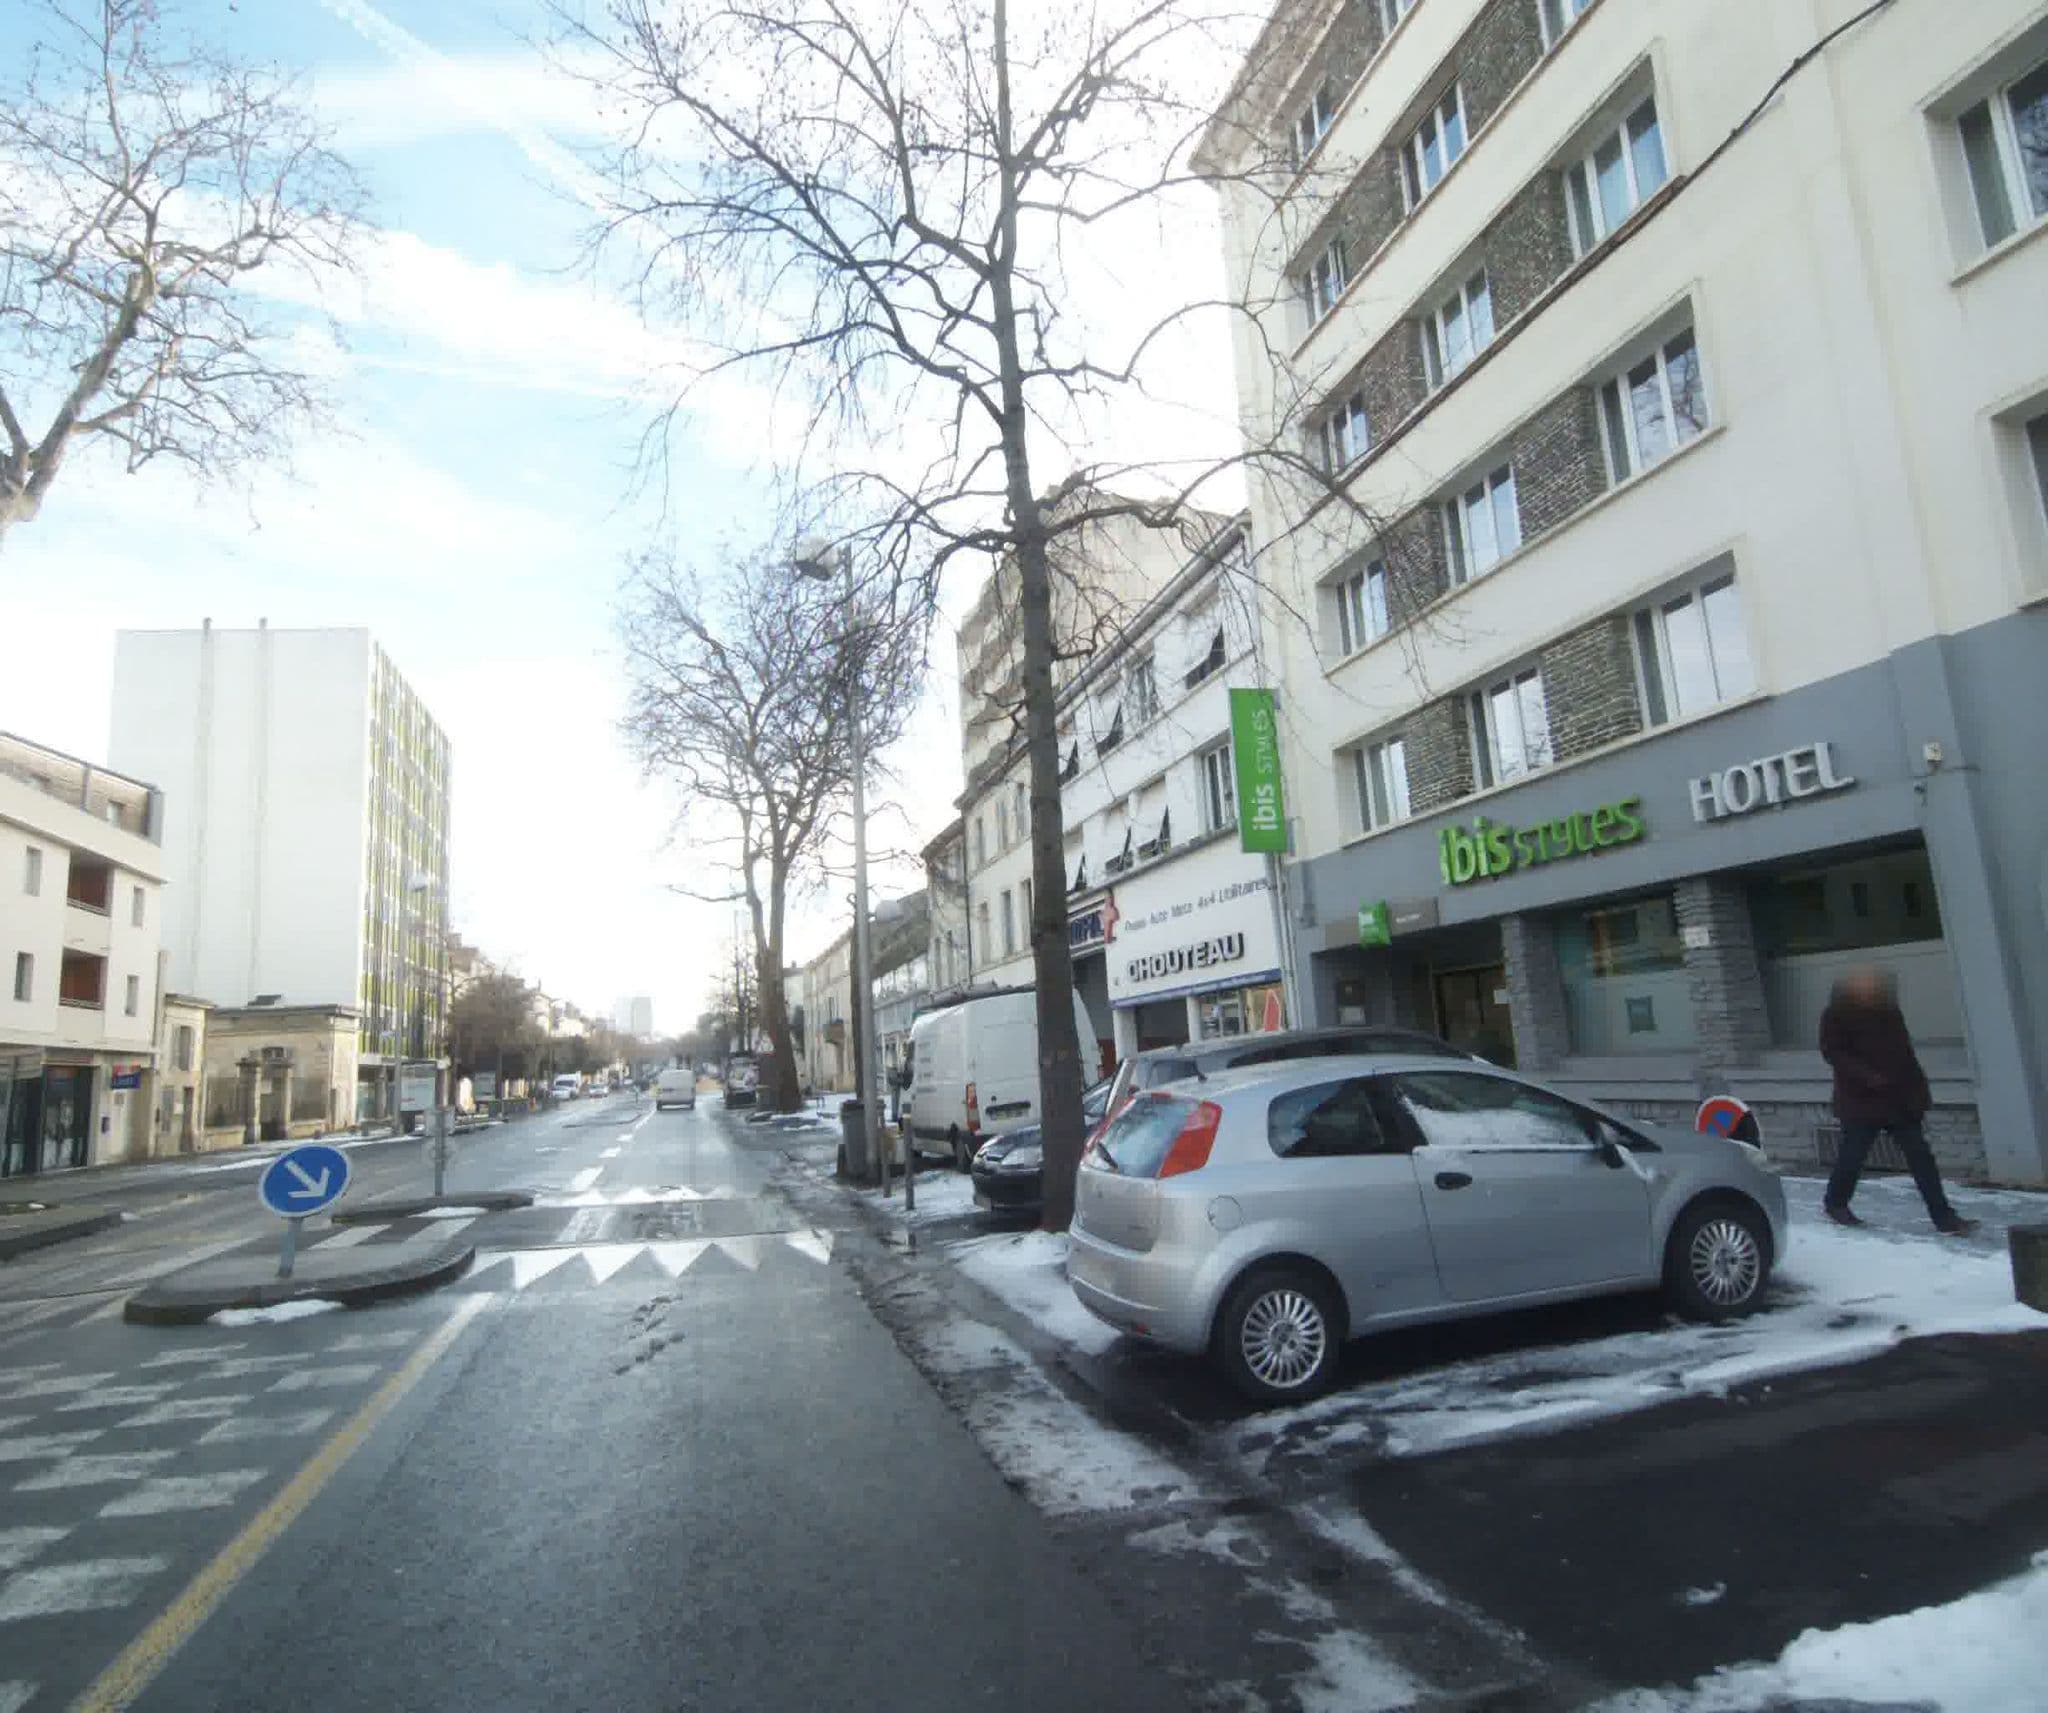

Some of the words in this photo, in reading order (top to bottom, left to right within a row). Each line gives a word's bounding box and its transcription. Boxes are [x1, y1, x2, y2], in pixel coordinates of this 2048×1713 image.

[1252, 783, 1278, 831] ibis
[1689, 742, 1855, 822] HOTEL
[1437, 815, 1513, 885] ibis
